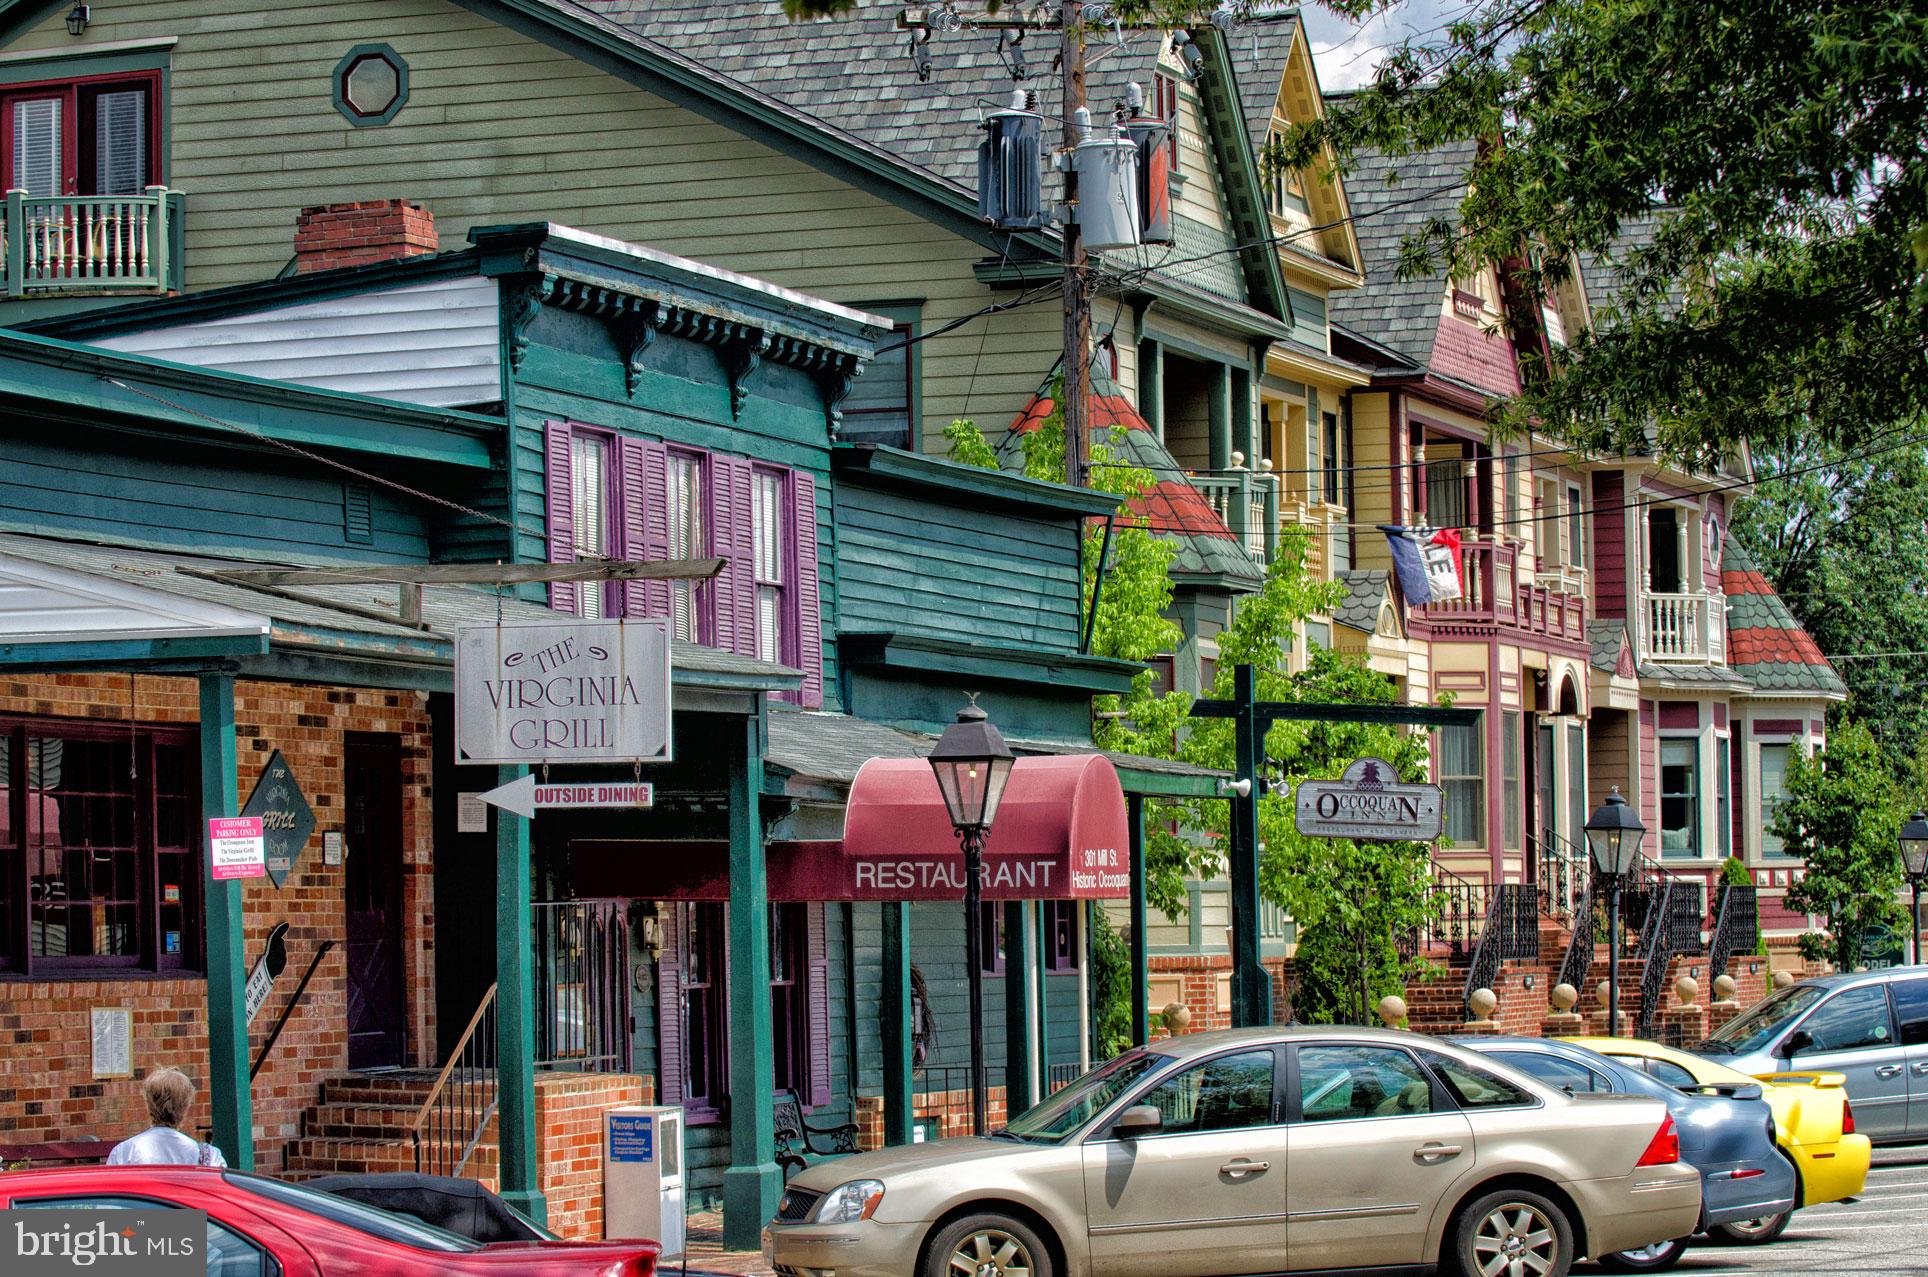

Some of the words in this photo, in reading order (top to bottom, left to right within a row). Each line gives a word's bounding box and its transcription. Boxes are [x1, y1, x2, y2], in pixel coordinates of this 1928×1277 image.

[531, 636, 580, 674] THE
[483, 675, 641, 710] VIRGINIA
[510, 718, 614, 750] GRILL
[534, 787, 595, 804] OUTSIDE
[598, 786, 649, 803] DINING
[1316, 792, 1422, 822] OCCOQUAN
[1350, 811, 1386, 820] INN
[220, 820, 251, 828] CUSTOMER
[263, 811, 296, 831] GRILL
[216, 829, 238, 837] PARKING
[1084, 849, 1096, 867] 301
[1097, 848, 1108, 867] Mill
[1072, 870, 1097, 889] Historic
[253, 971, 263, 989] EAT
